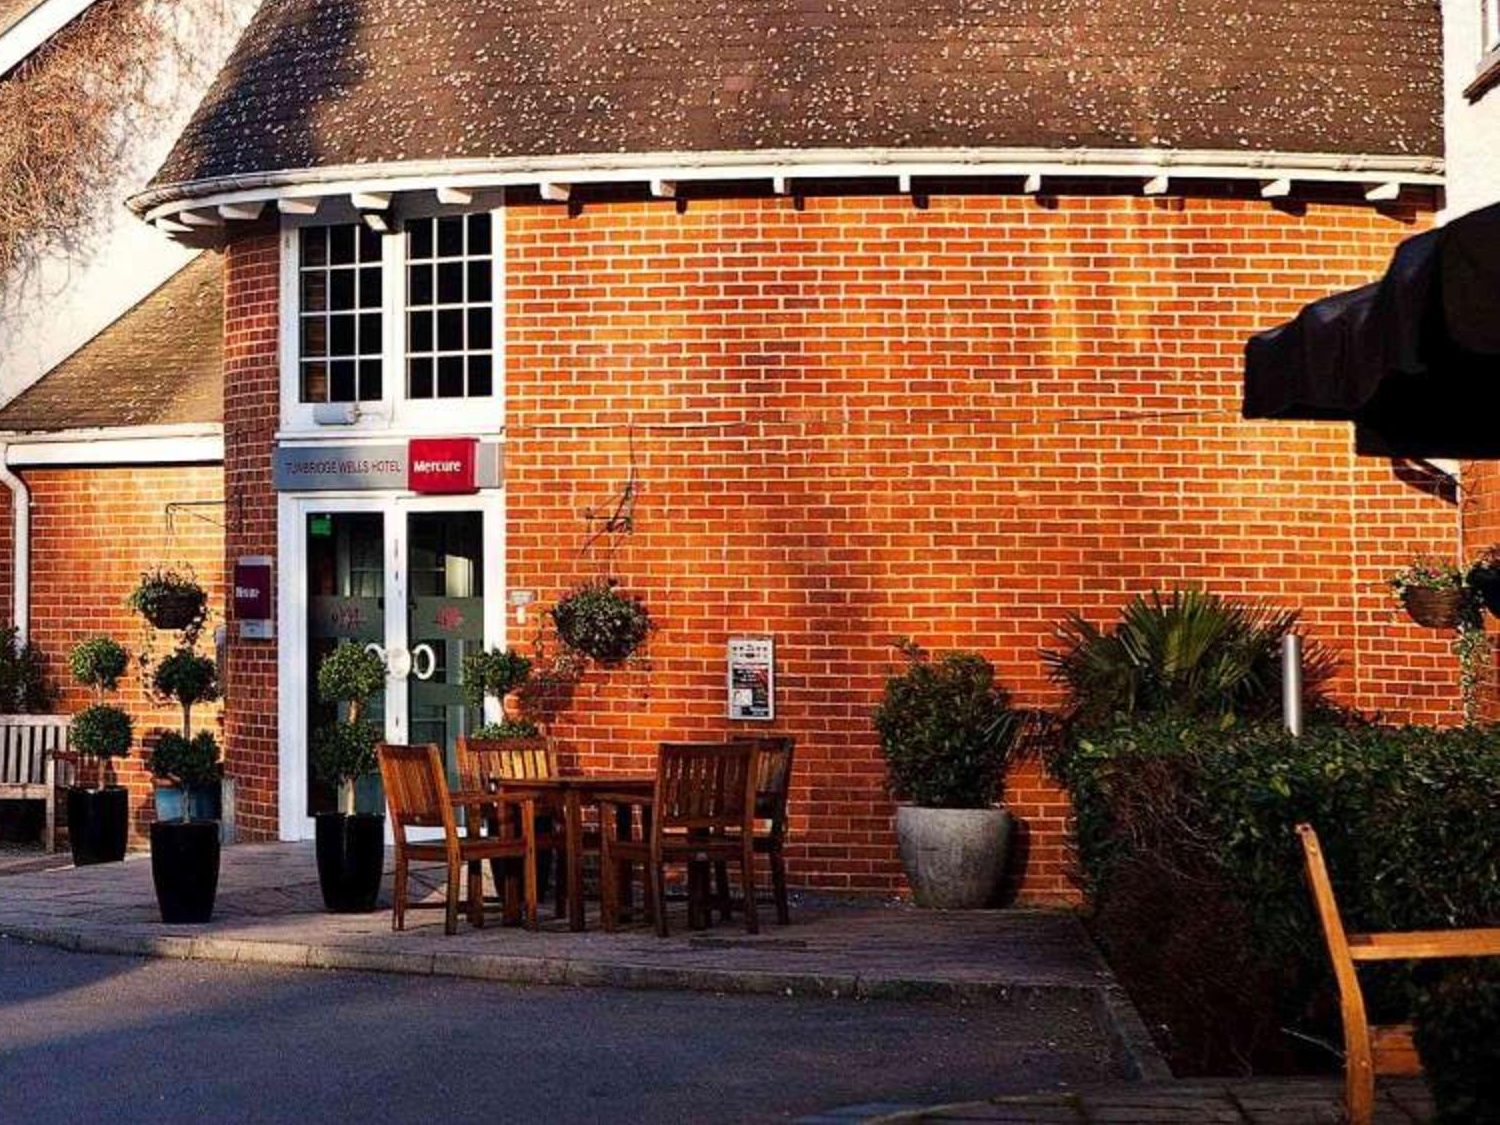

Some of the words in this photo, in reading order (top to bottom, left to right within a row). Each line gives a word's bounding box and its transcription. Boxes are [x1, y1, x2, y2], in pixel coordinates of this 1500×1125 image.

[338, 460, 369, 473] WELLS
[371, 460, 401, 473] HOTEL
[413, 461, 461, 473] Mercure
